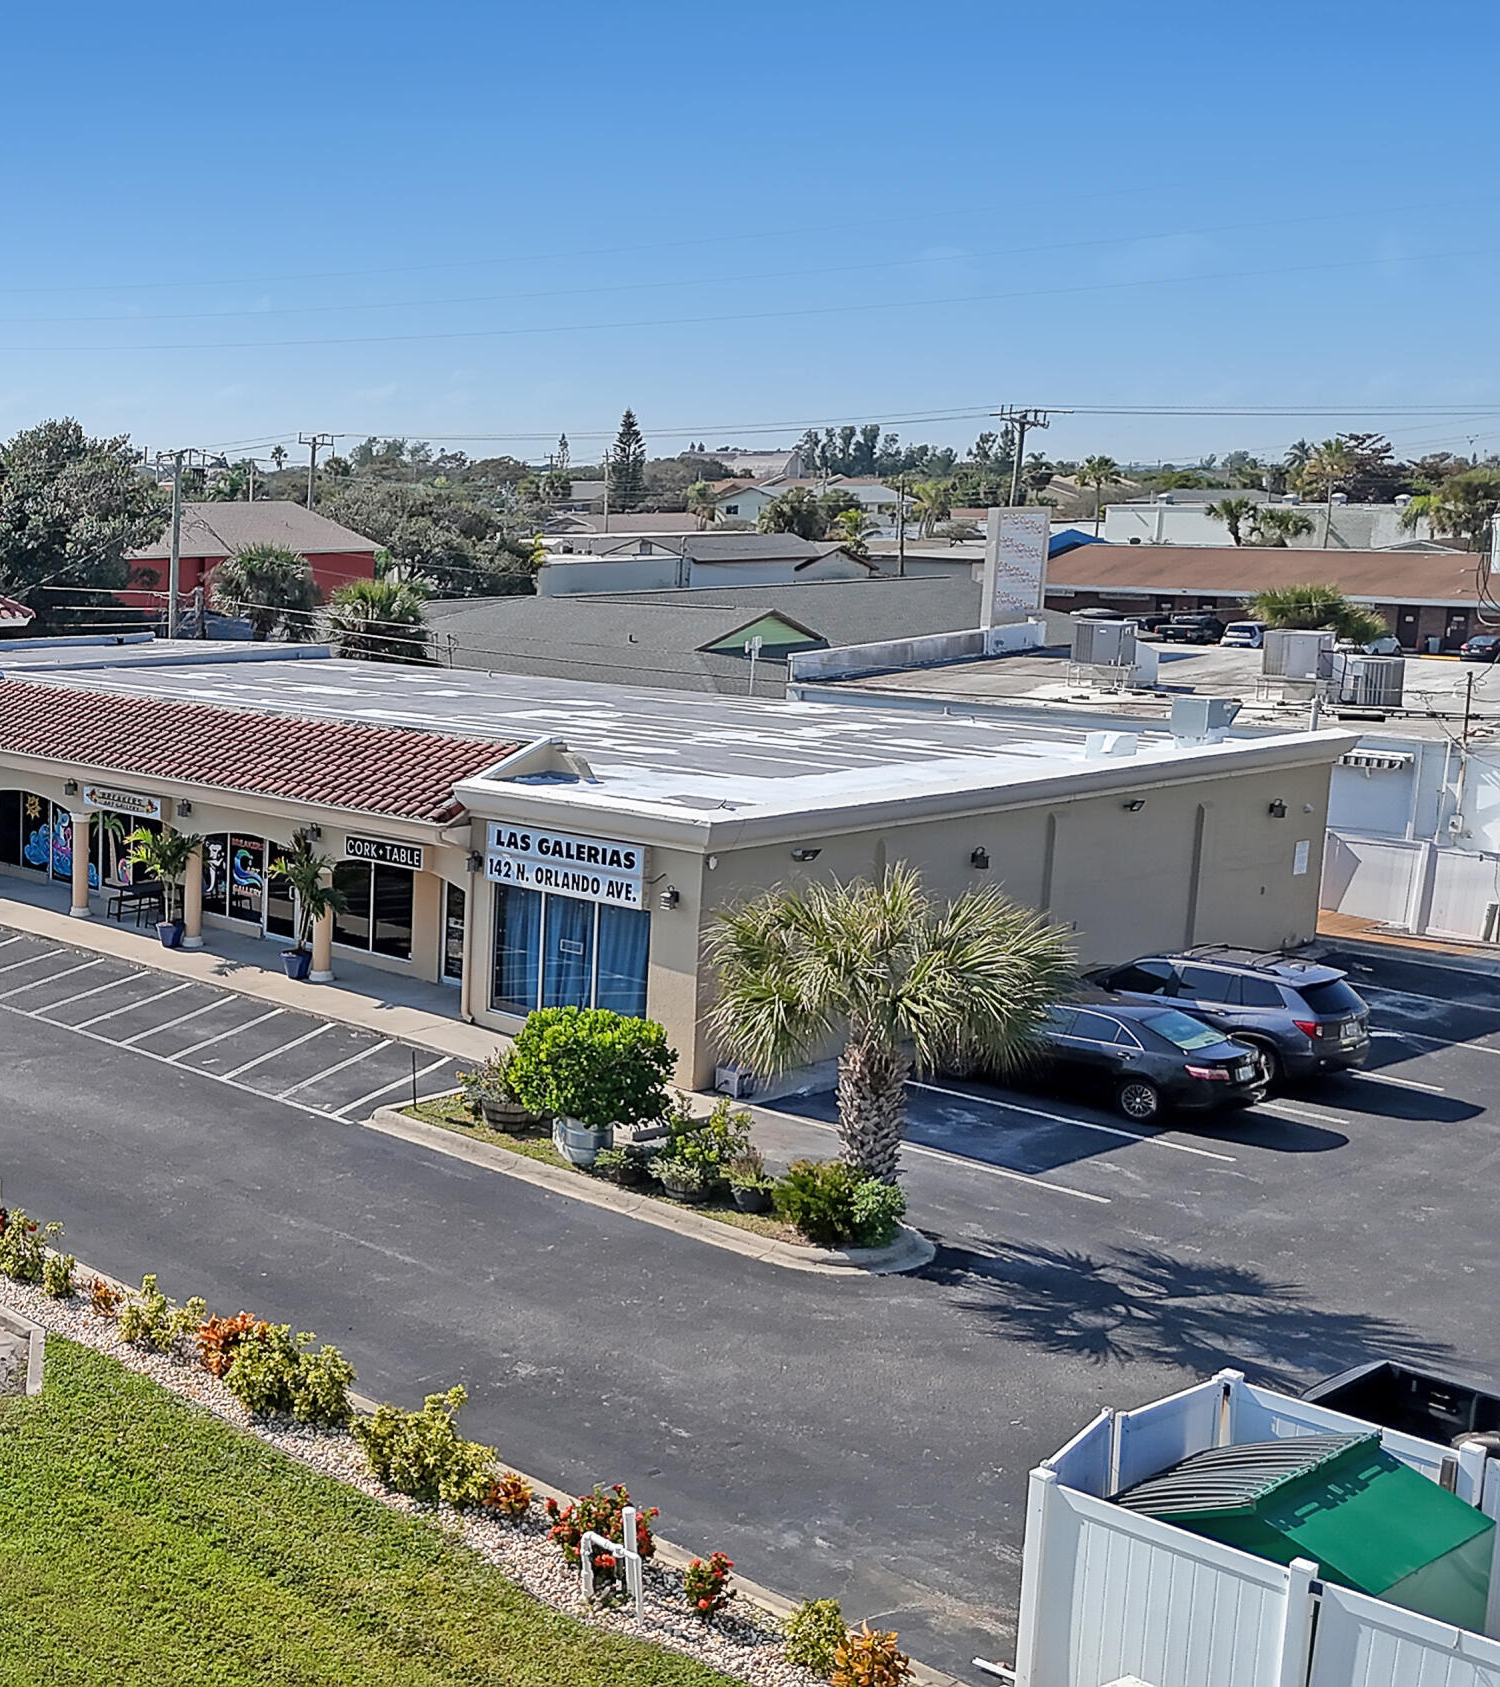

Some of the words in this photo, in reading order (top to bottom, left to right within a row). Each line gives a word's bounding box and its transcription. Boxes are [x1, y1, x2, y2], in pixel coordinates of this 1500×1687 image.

[495, 828, 532, 851] LAS
[537, 837, 636, 870] GALERIAS
[488, 858, 512, 879] 142
[516, 863, 530, 882] N.
[535, 867, 601, 895] ORLANDO
[606, 880, 637, 902] AVE.
